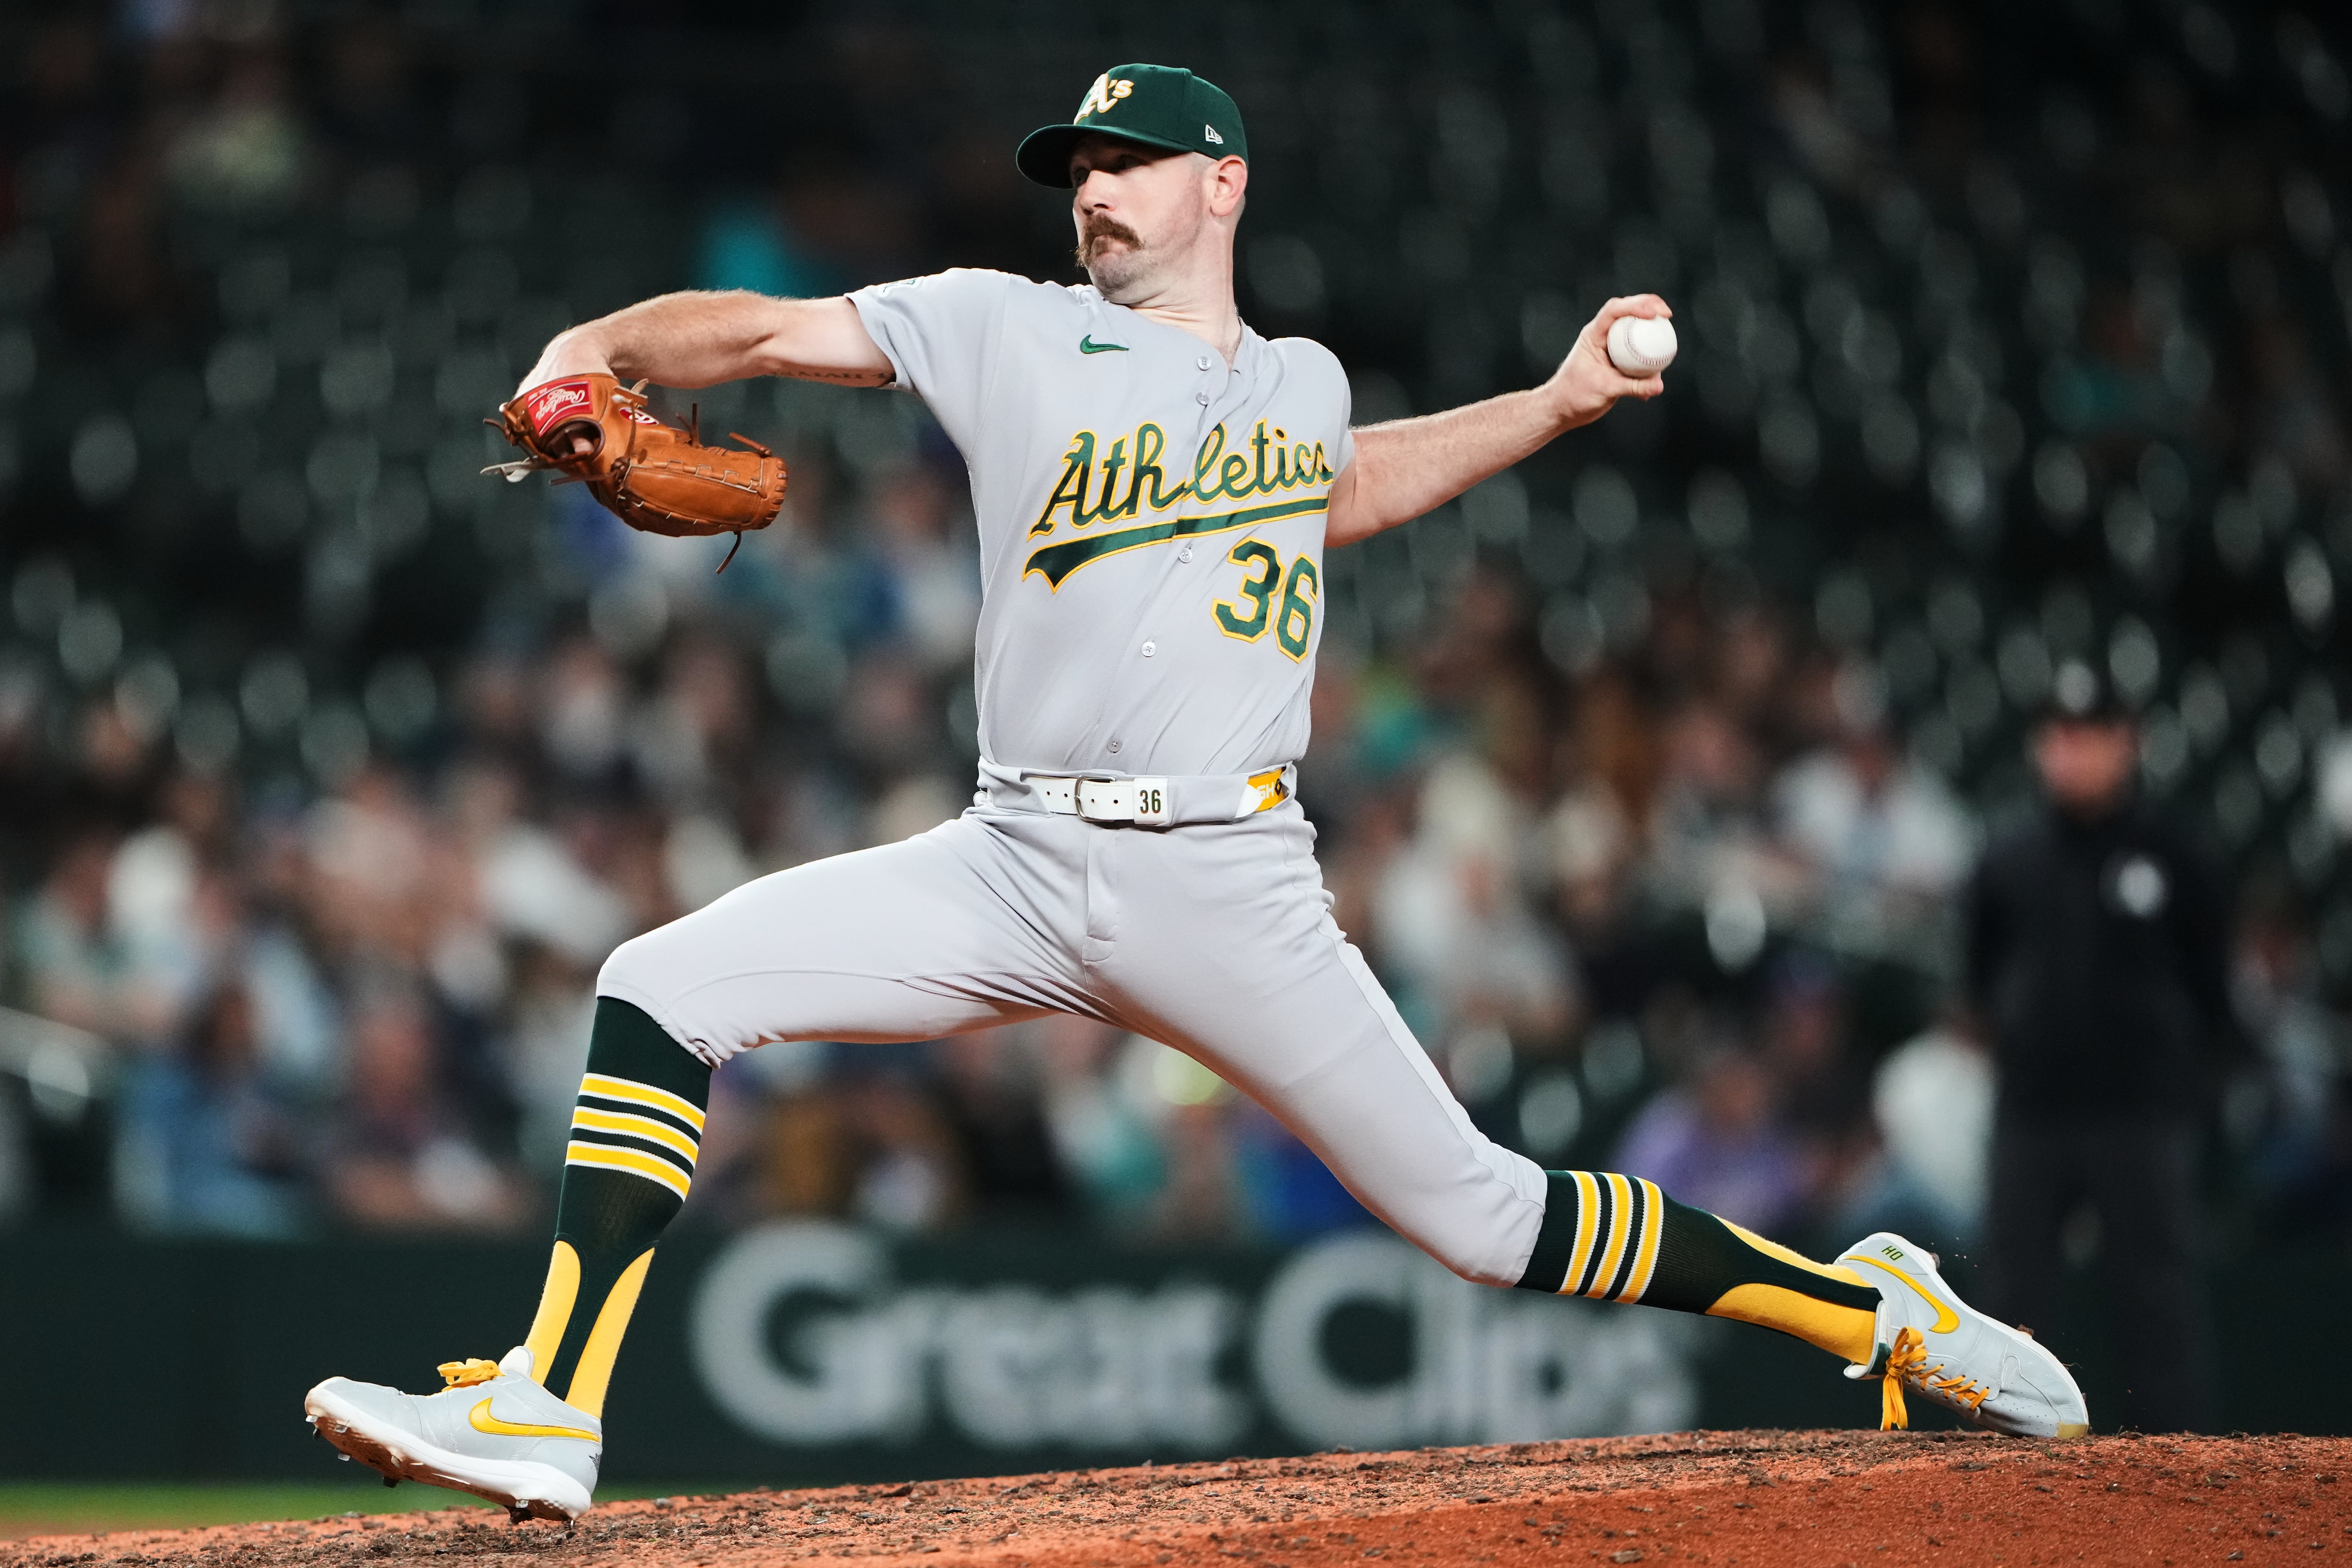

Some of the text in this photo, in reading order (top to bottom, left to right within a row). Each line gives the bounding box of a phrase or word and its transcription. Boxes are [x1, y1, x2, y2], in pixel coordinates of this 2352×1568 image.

[1074, 73, 1134, 124] A's
[1211, 536, 1319, 664] 36
[1139, 789, 1161, 814] 36
[691, 1223, 1244, 1448] Great
